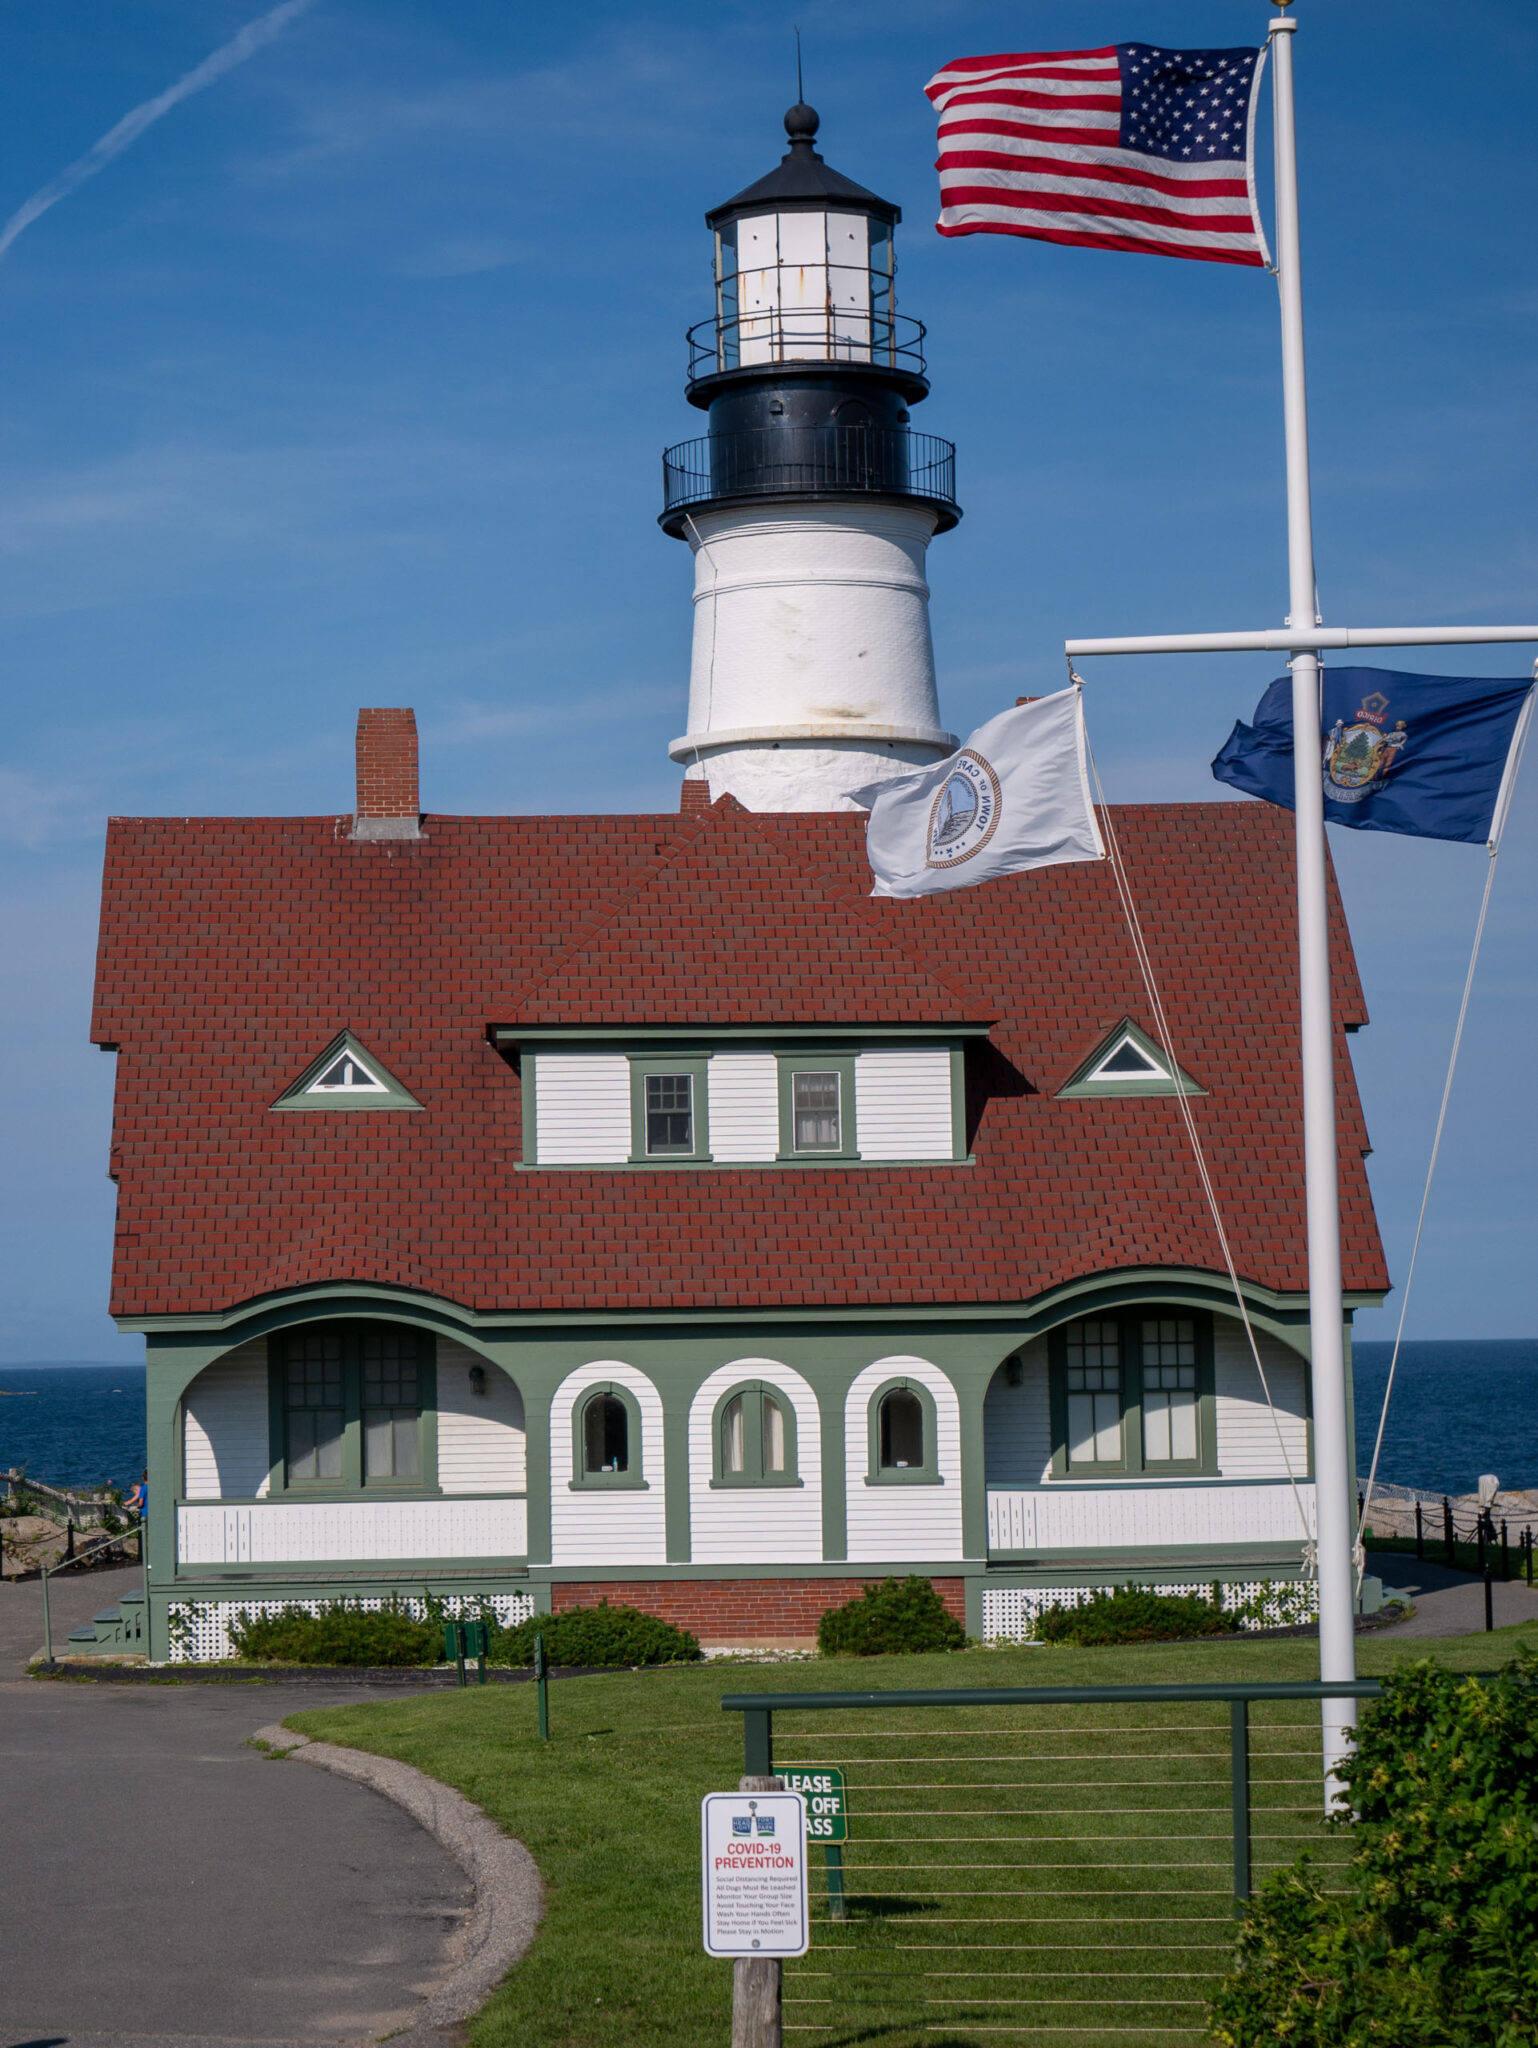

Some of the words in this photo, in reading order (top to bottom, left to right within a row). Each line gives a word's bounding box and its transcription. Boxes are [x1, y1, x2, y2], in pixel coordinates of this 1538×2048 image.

[775, 1775, 832, 1793] LEASE
[811, 1796, 840, 1815] OFF
[806, 1817, 833, 1836] ASS
[727, 1843, 782, 1855] COVID-19
[715, 1856, 794, 1870] PREVENTION
